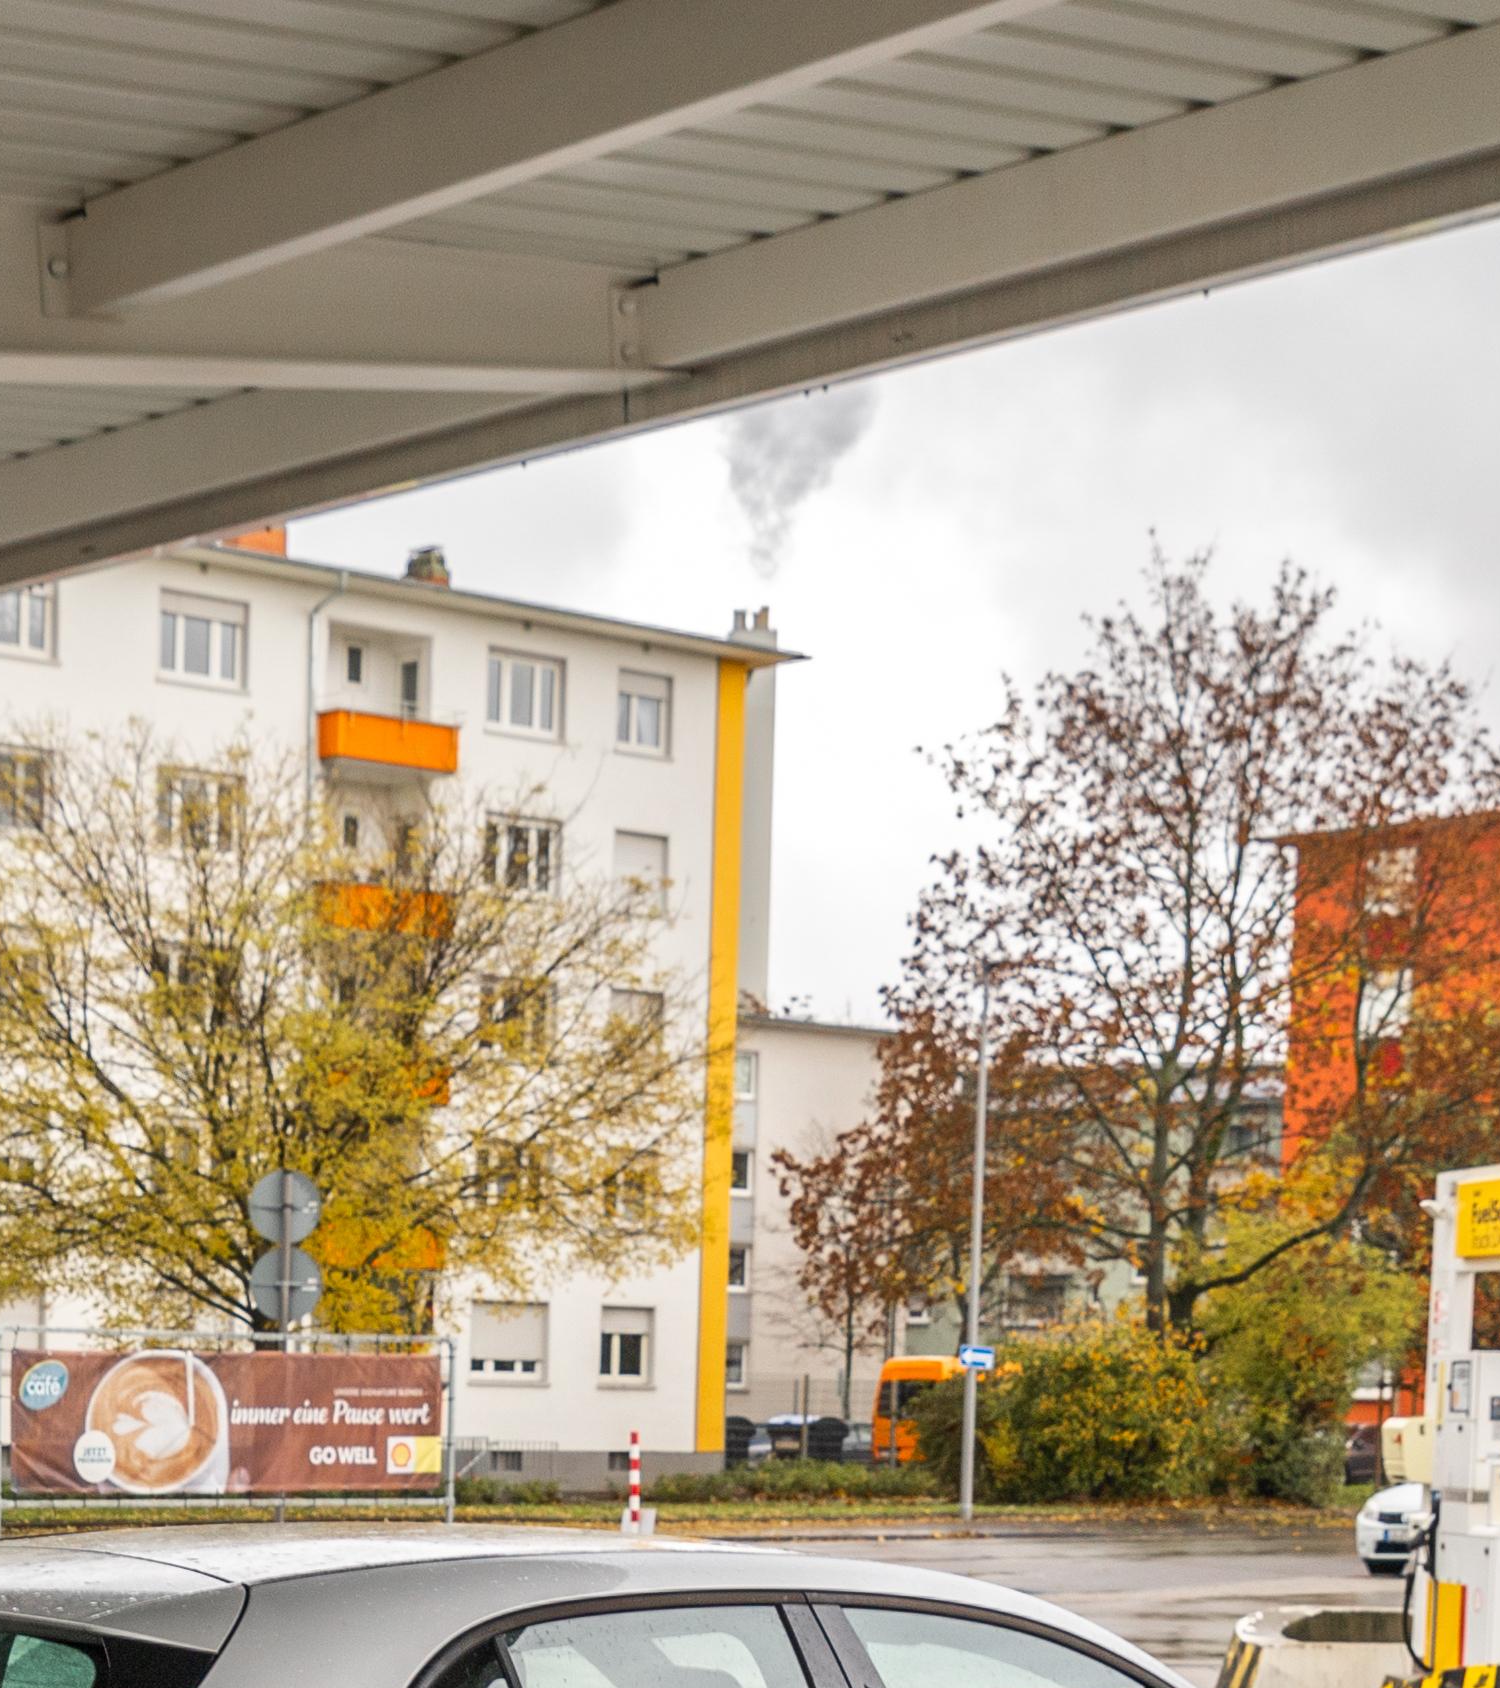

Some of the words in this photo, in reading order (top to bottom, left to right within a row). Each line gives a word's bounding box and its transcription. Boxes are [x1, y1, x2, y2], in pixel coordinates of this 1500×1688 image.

[231, 1399, 290, 1425] immer
[293, 1399, 329, 1425] eine
[332, 1400, 386, 1425] Pause
[389, 1403, 431, 1425] wert
[309, 1445, 337, 1464] GO
[338, 1447, 378, 1464] WELL
